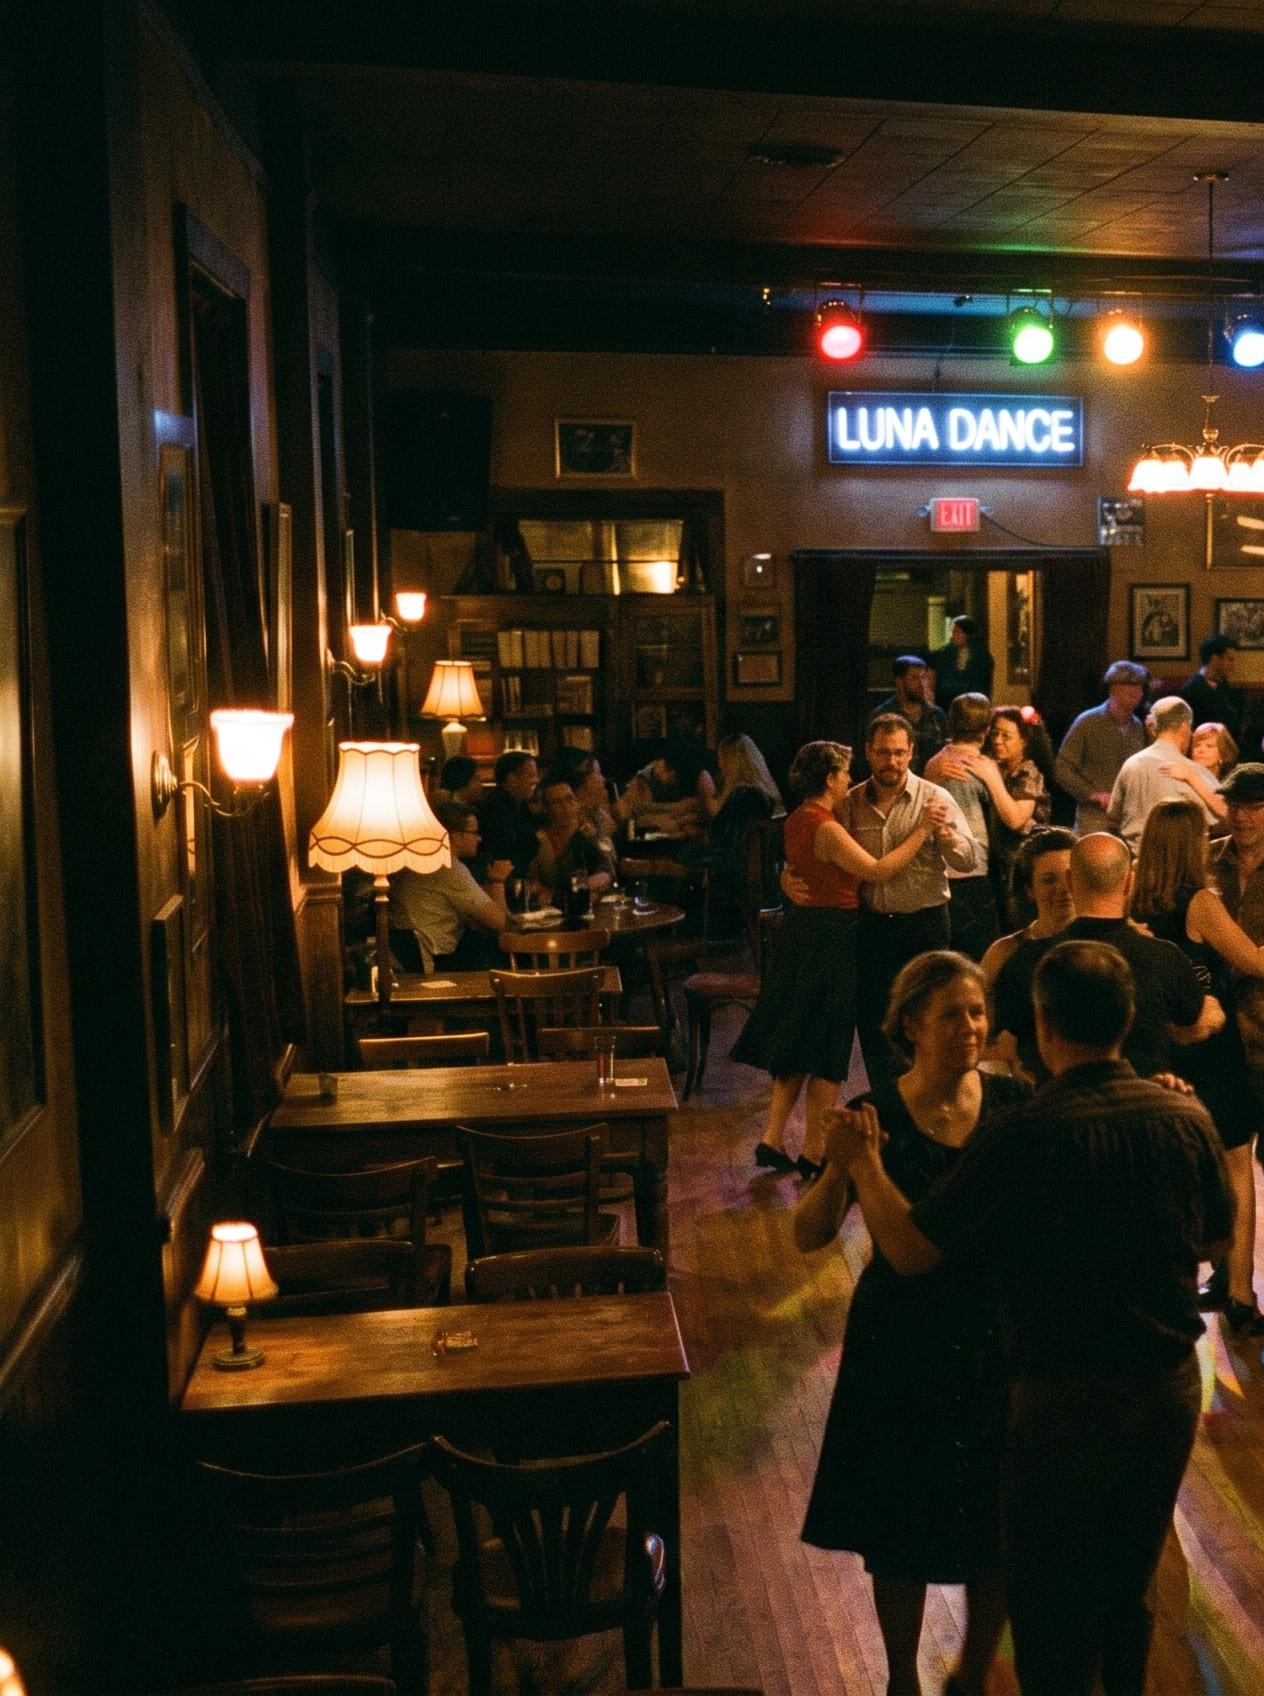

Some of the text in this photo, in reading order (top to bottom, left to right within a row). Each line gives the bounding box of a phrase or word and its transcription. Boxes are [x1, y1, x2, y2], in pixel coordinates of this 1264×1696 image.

[838, 407, 1075, 452] LUNA DANCE
[940, 502, 973, 527] EXIT
